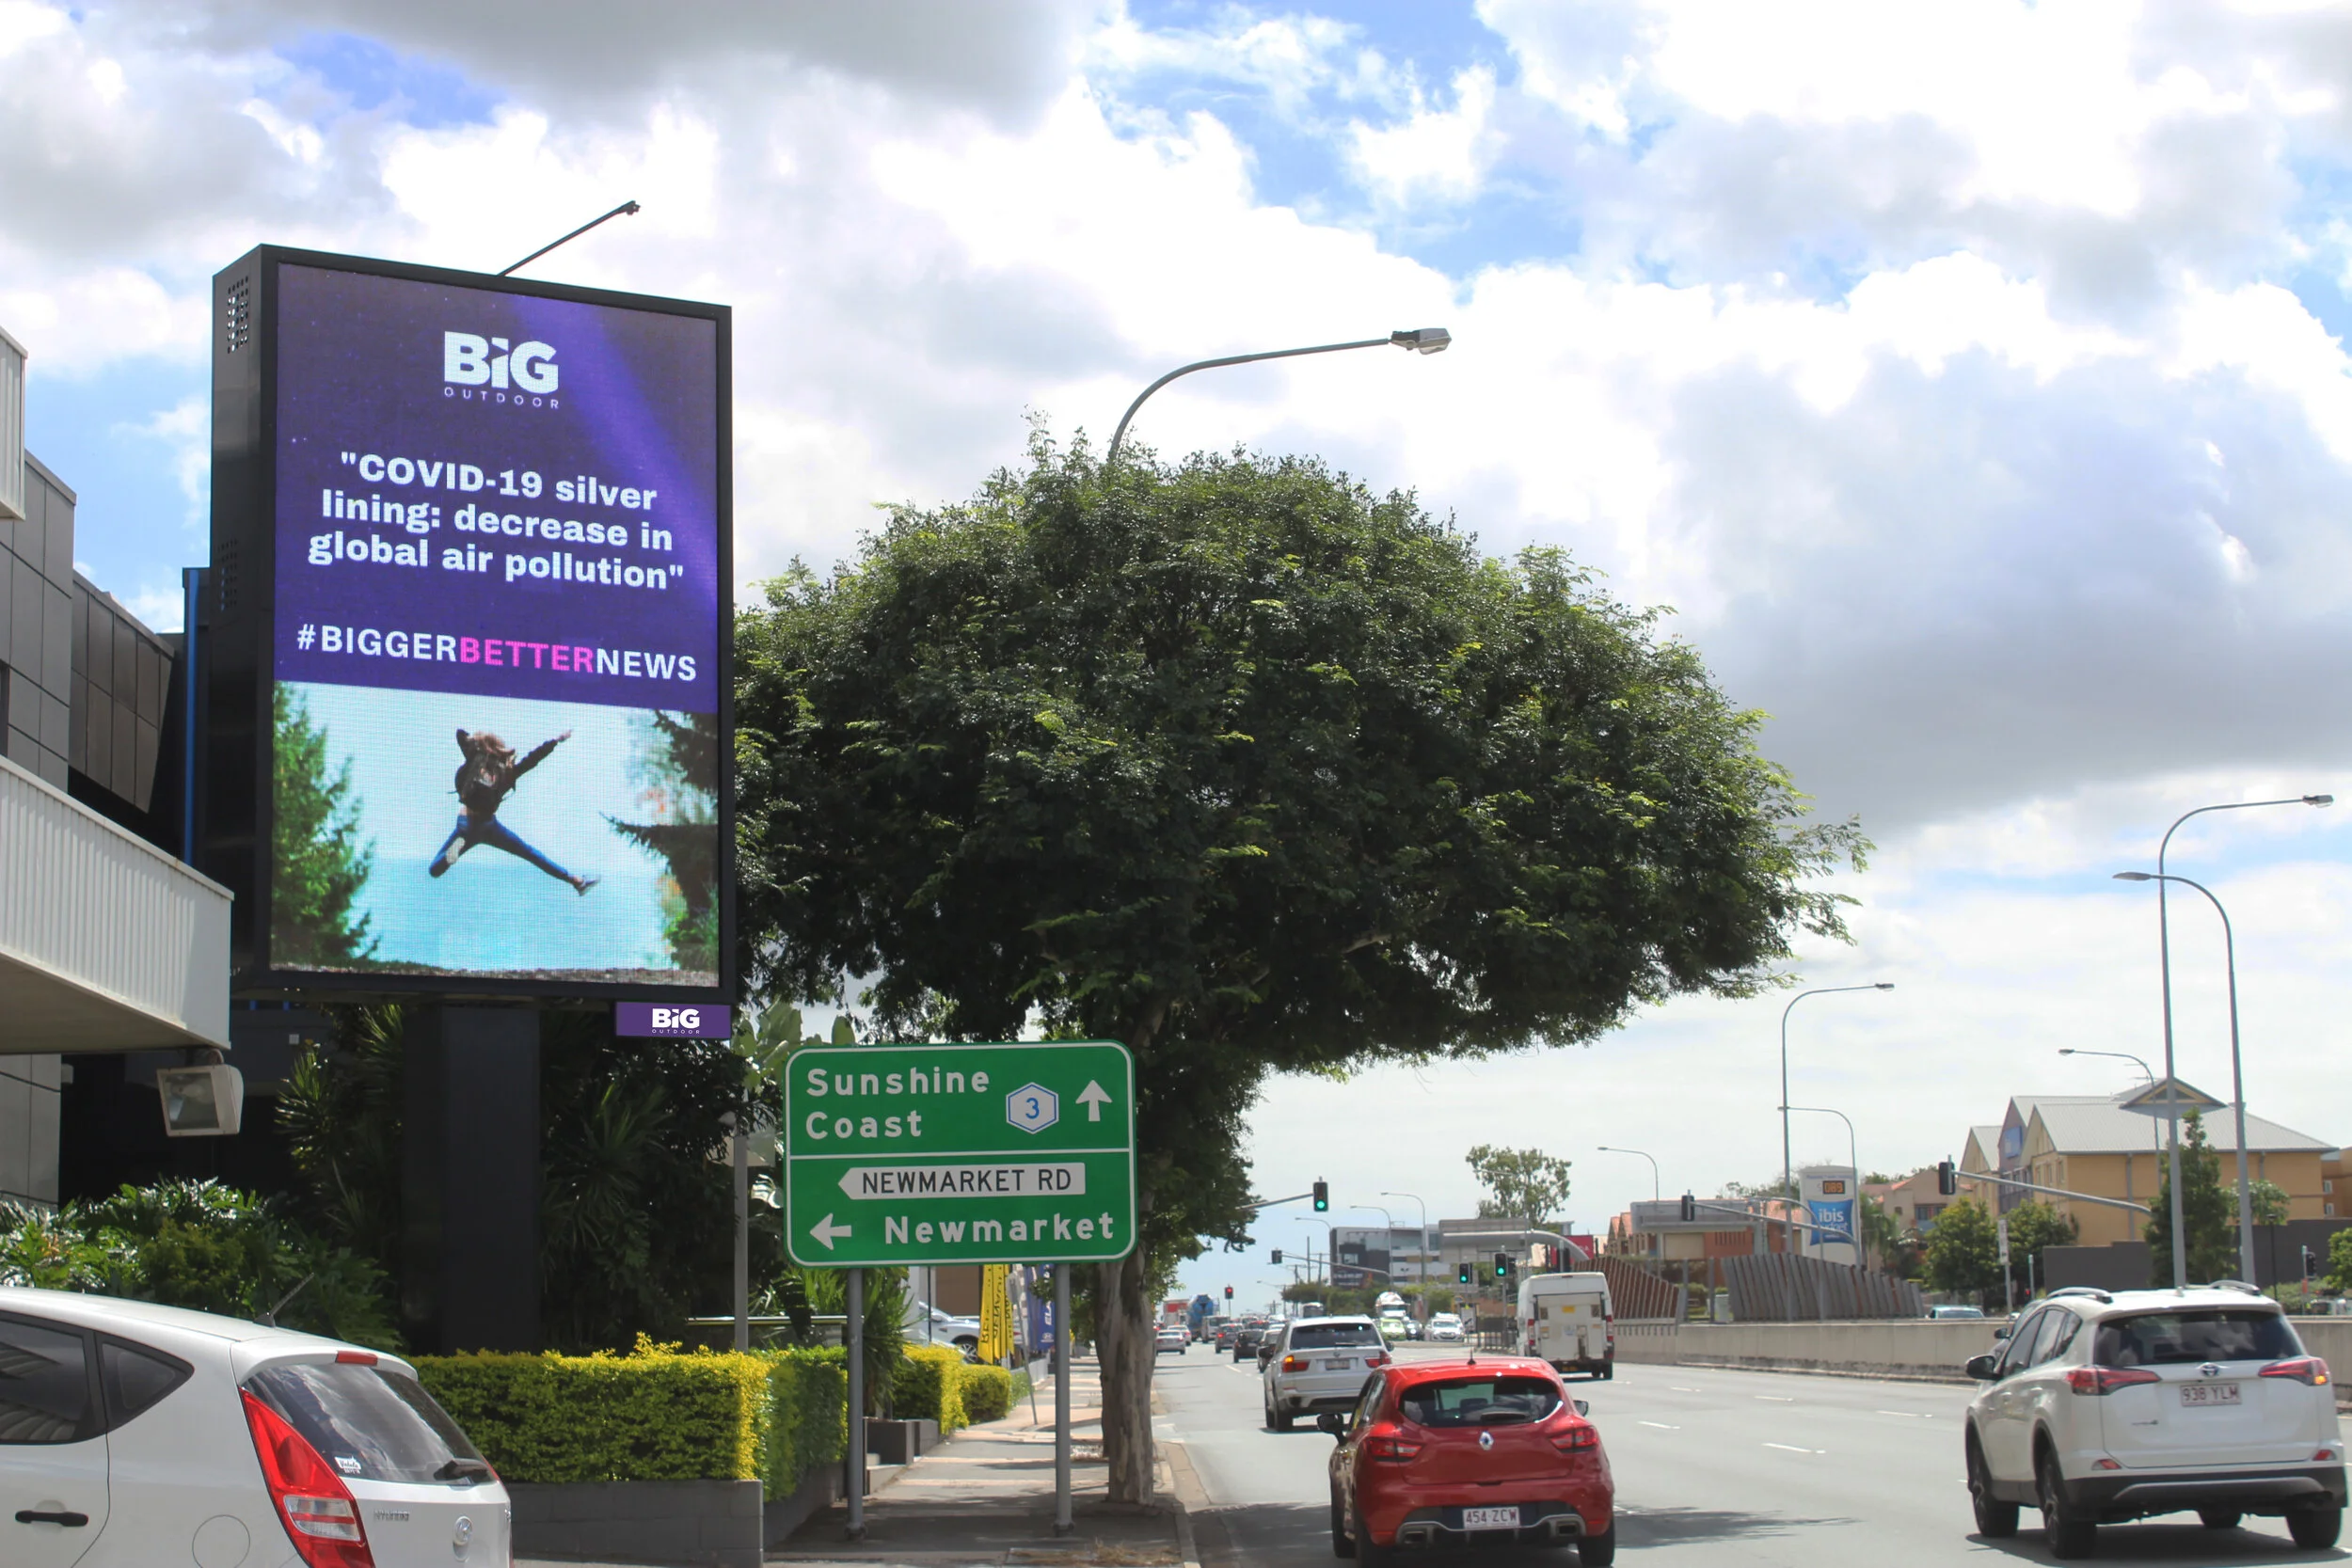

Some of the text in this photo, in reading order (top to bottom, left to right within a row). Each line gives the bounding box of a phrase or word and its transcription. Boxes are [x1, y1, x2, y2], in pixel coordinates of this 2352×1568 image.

[444, 386, 559, 409] OUTDOOR
[341, 451, 657, 510] "COVID-19 silver
[322, 489, 674, 551] lining: decrease in
[308, 531, 685, 590] global air pollution"
[806, 1066, 990, 1098] Sunshine
[1025, 1097, 1041, 1120] 3
[805, 1109, 923, 1140] Coast
[863, 1168, 1072, 1195] NEWMARKET RD
[884, 1212, 1115, 1245] Newmarket
[1819, 1209, 1844, 1222] ibis
